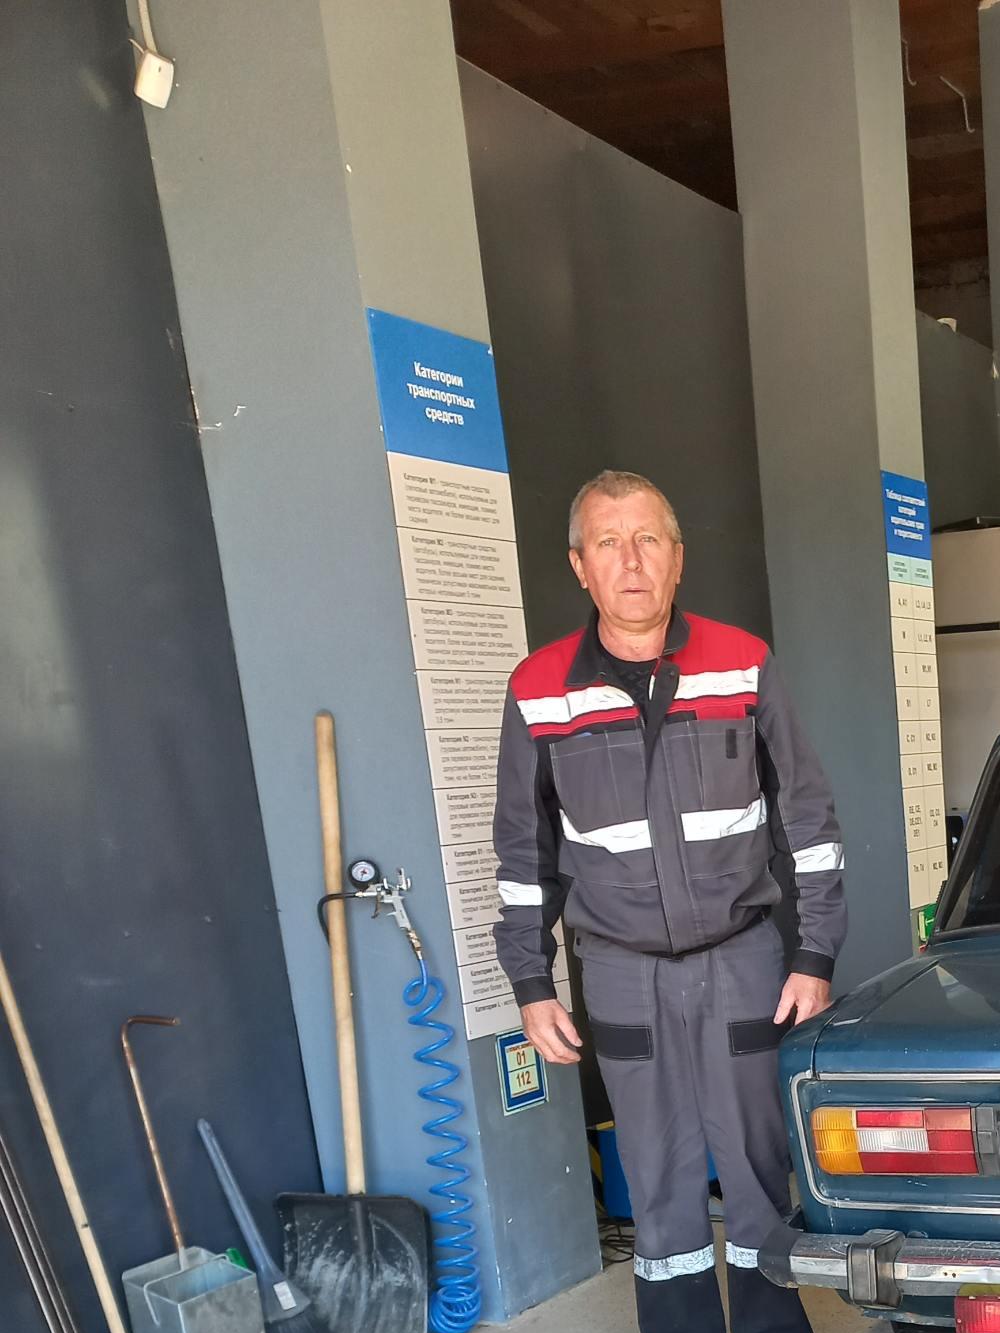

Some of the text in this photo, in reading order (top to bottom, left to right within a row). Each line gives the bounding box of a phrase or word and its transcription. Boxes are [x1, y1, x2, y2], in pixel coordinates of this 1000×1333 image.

[413, 361, 464, 387] Категории
[407, 383, 475, 409] транспортных
[425, 407, 464, 425] средств
[516, 1050, 527, 1066] 01
[516, 1071, 532, 1088] 112
